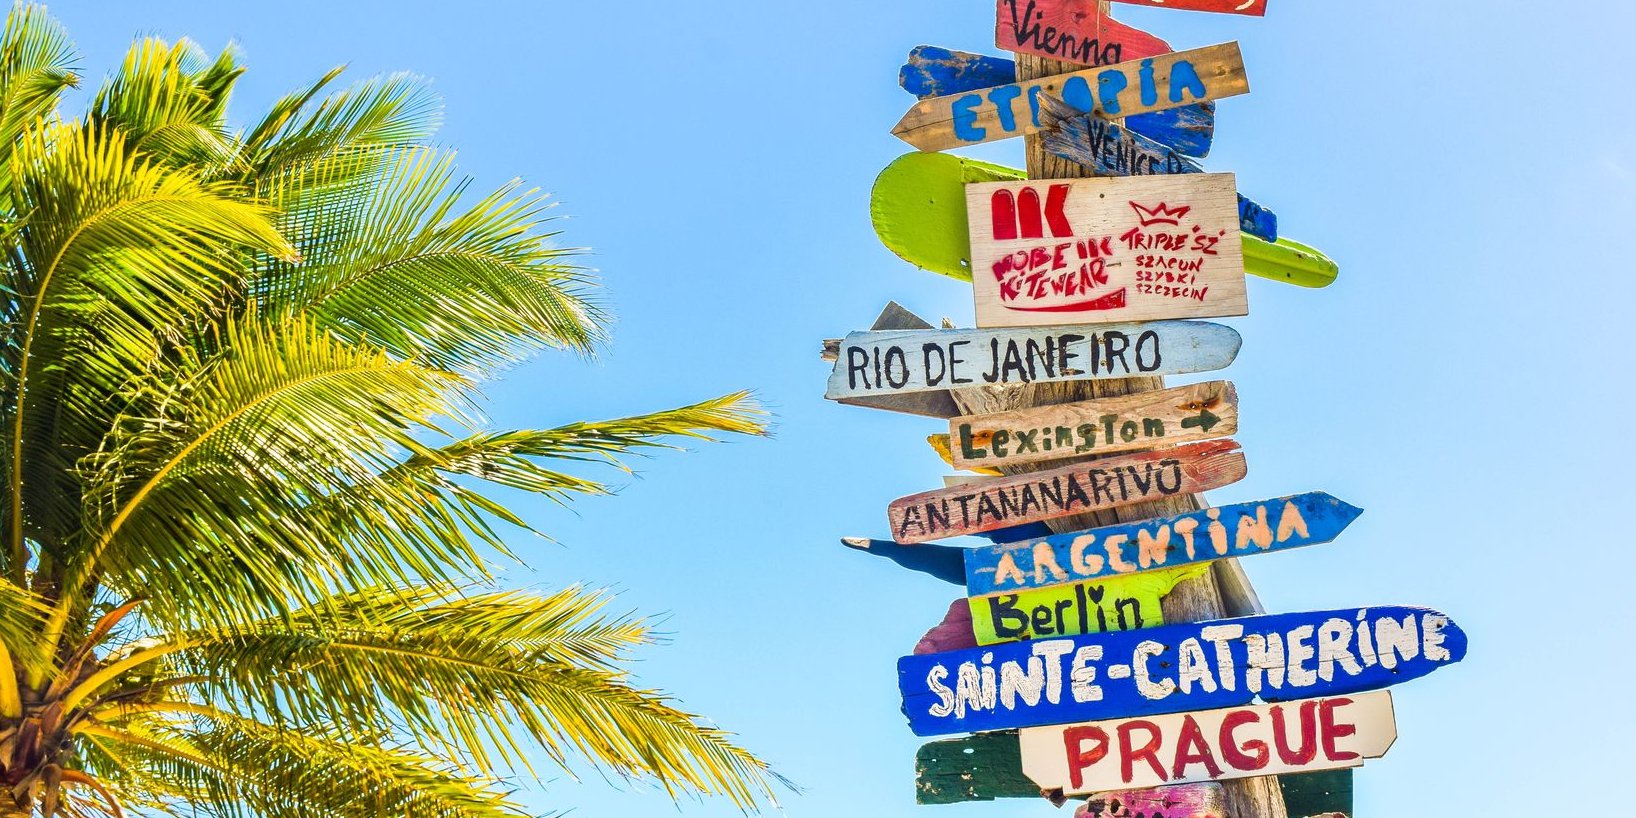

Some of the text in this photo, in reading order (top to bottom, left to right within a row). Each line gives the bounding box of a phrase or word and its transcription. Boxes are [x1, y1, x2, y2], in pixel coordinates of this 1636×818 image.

[1003, 0, 1121, 65] Vienna
[1120, 227, 1188, 251] TRIPLE
[1136, 283, 1208, 301] SZCZECIN
[847, 330, 1162, 390] RIO DE JANEIRO
[900, 459, 1182, 538] ANTANANARIVO
[988, 584, 1144, 638] Berlin
[1064, 697, 1361, 790] PRAGUE
